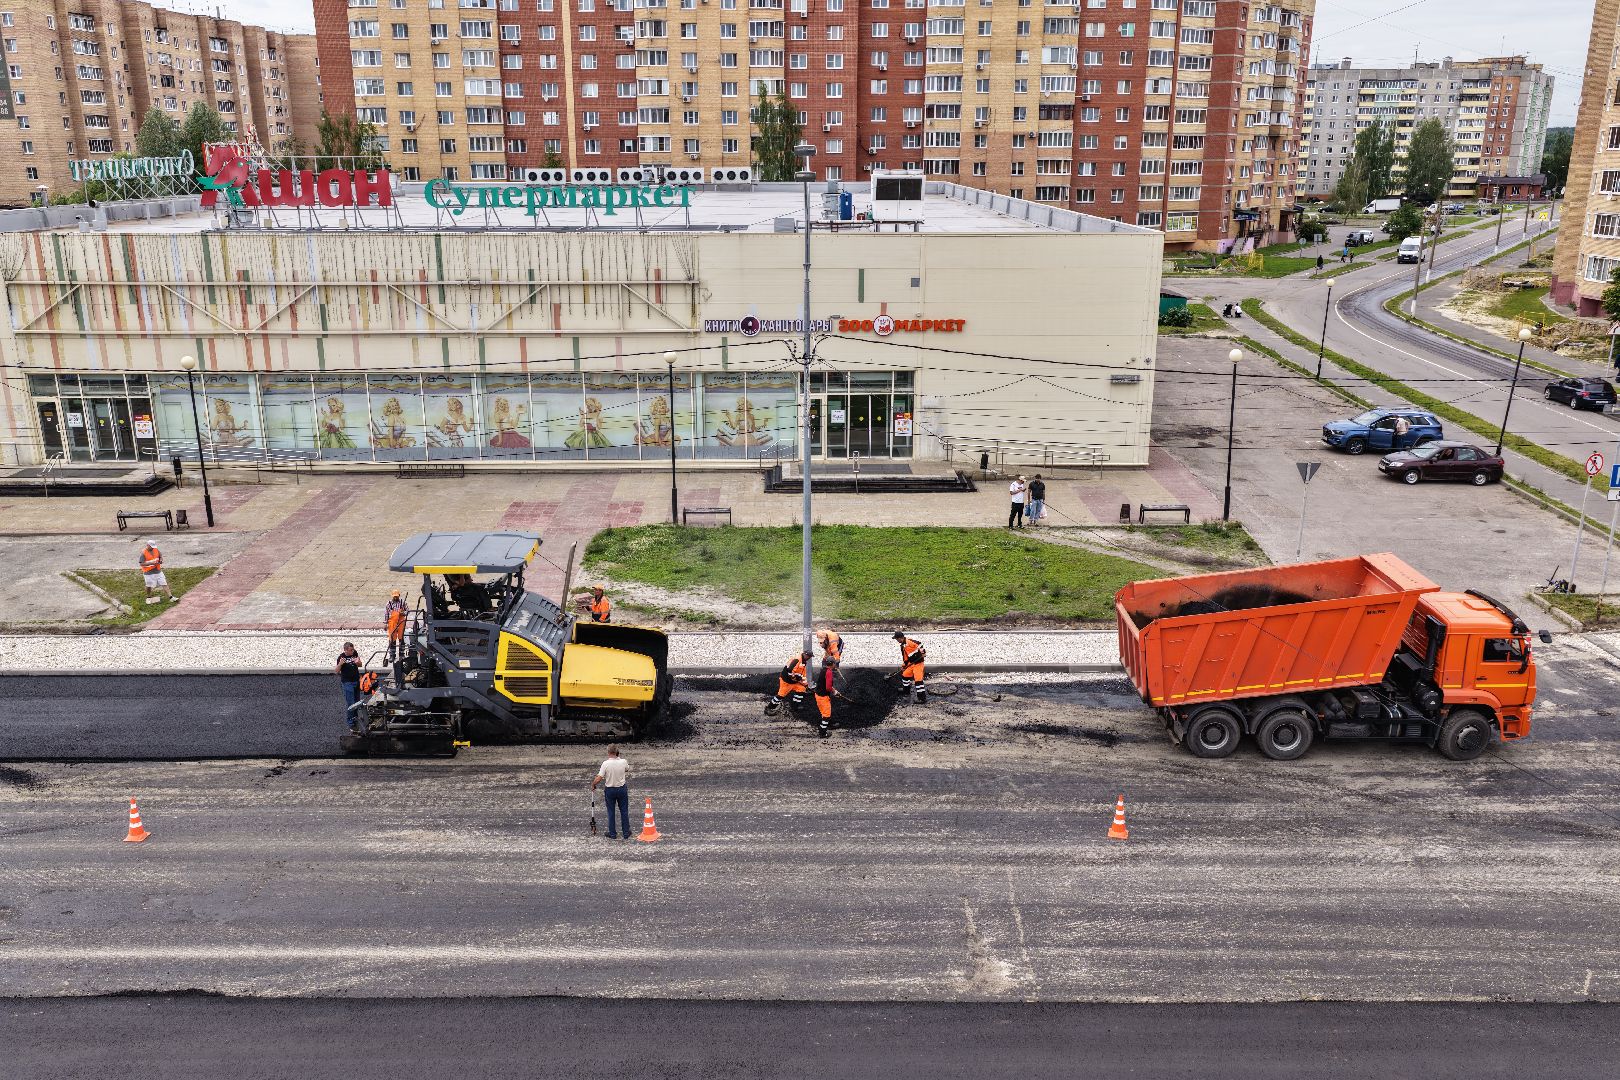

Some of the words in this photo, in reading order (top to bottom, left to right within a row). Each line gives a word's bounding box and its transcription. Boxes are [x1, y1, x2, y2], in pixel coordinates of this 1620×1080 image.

[424, 178, 697, 217] Супермаркет
[705, 319, 739, 332] КНИГИ
[838, 319, 873, 332] ЗОО
[894, 319, 966, 332] МАРКЕТ
